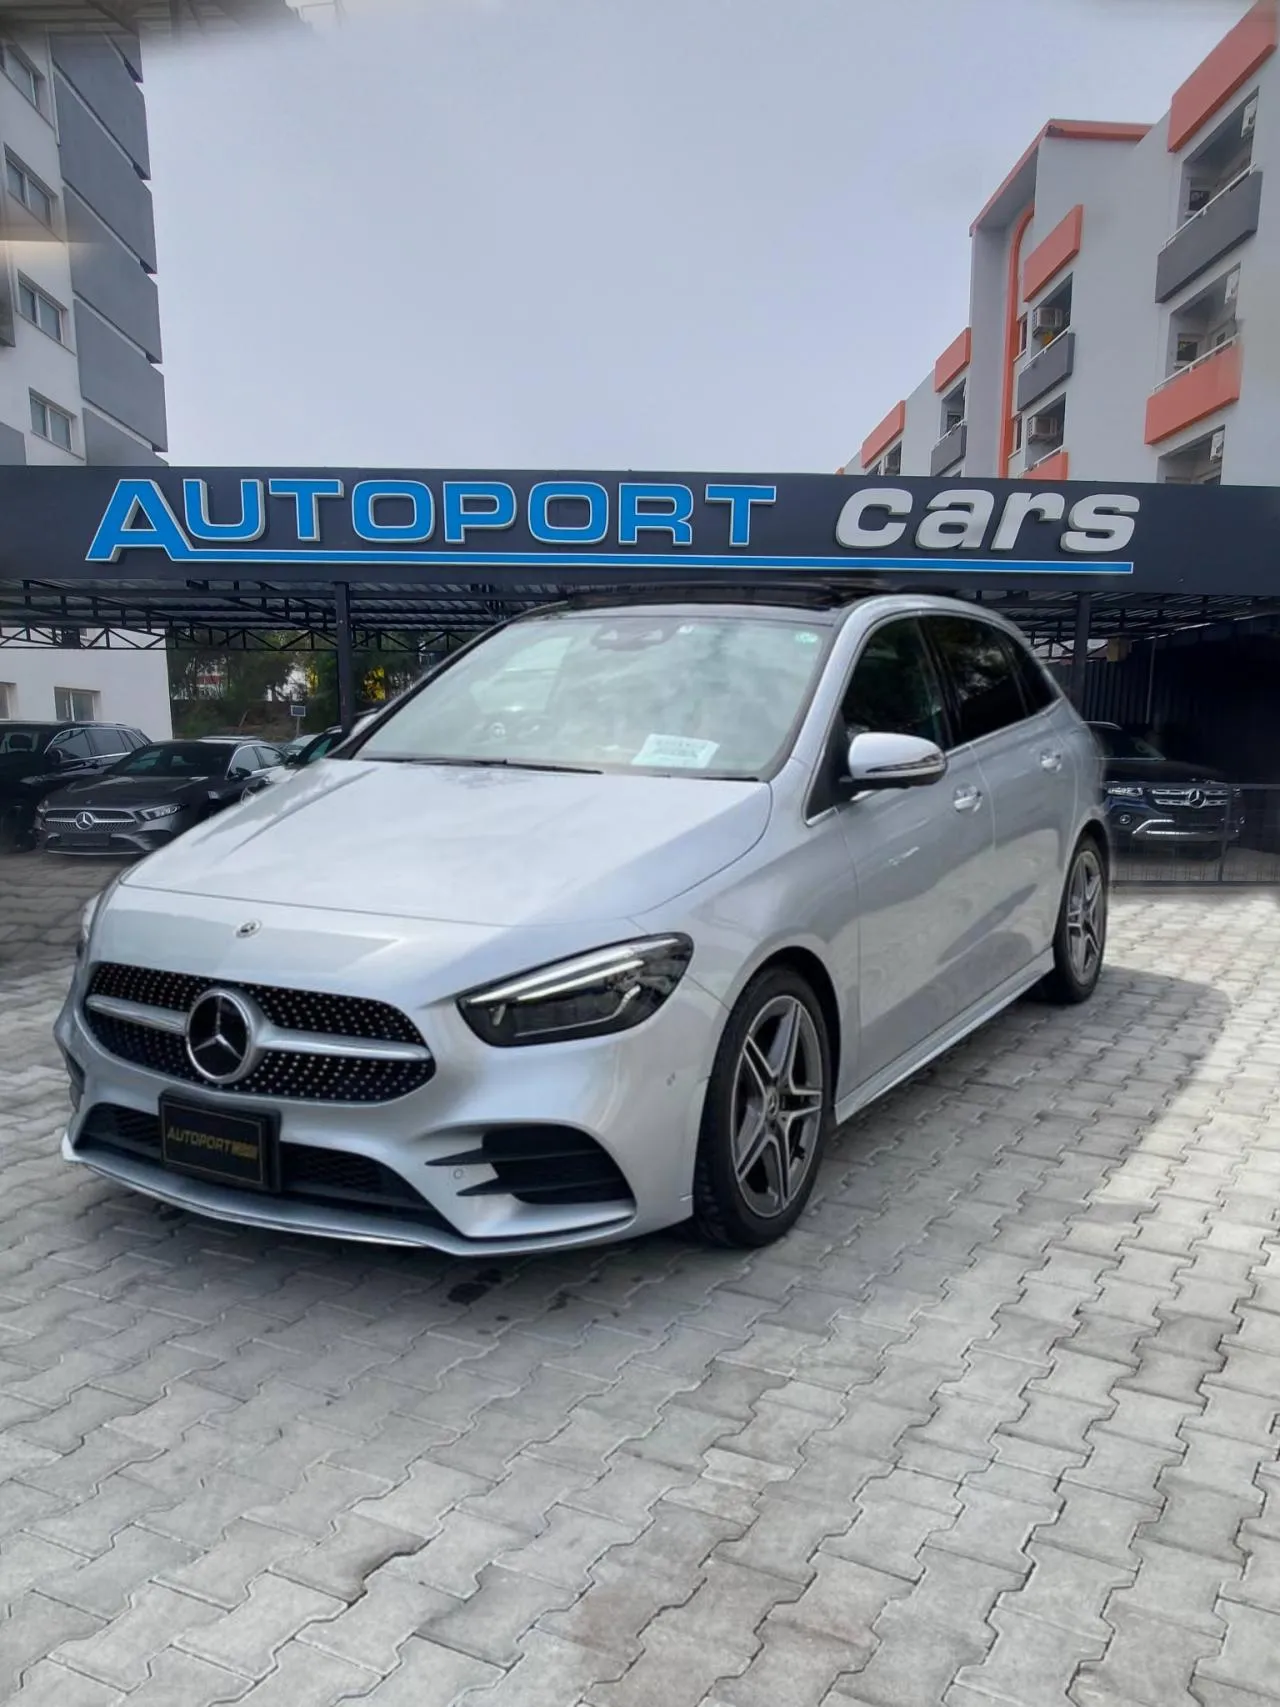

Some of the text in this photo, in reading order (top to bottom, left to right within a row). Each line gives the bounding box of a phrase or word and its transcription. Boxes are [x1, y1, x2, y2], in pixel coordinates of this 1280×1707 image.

[85, 478, 1141, 563] AUTOPORT cars
[167, 1126, 232, 1154] AUTOPORT
